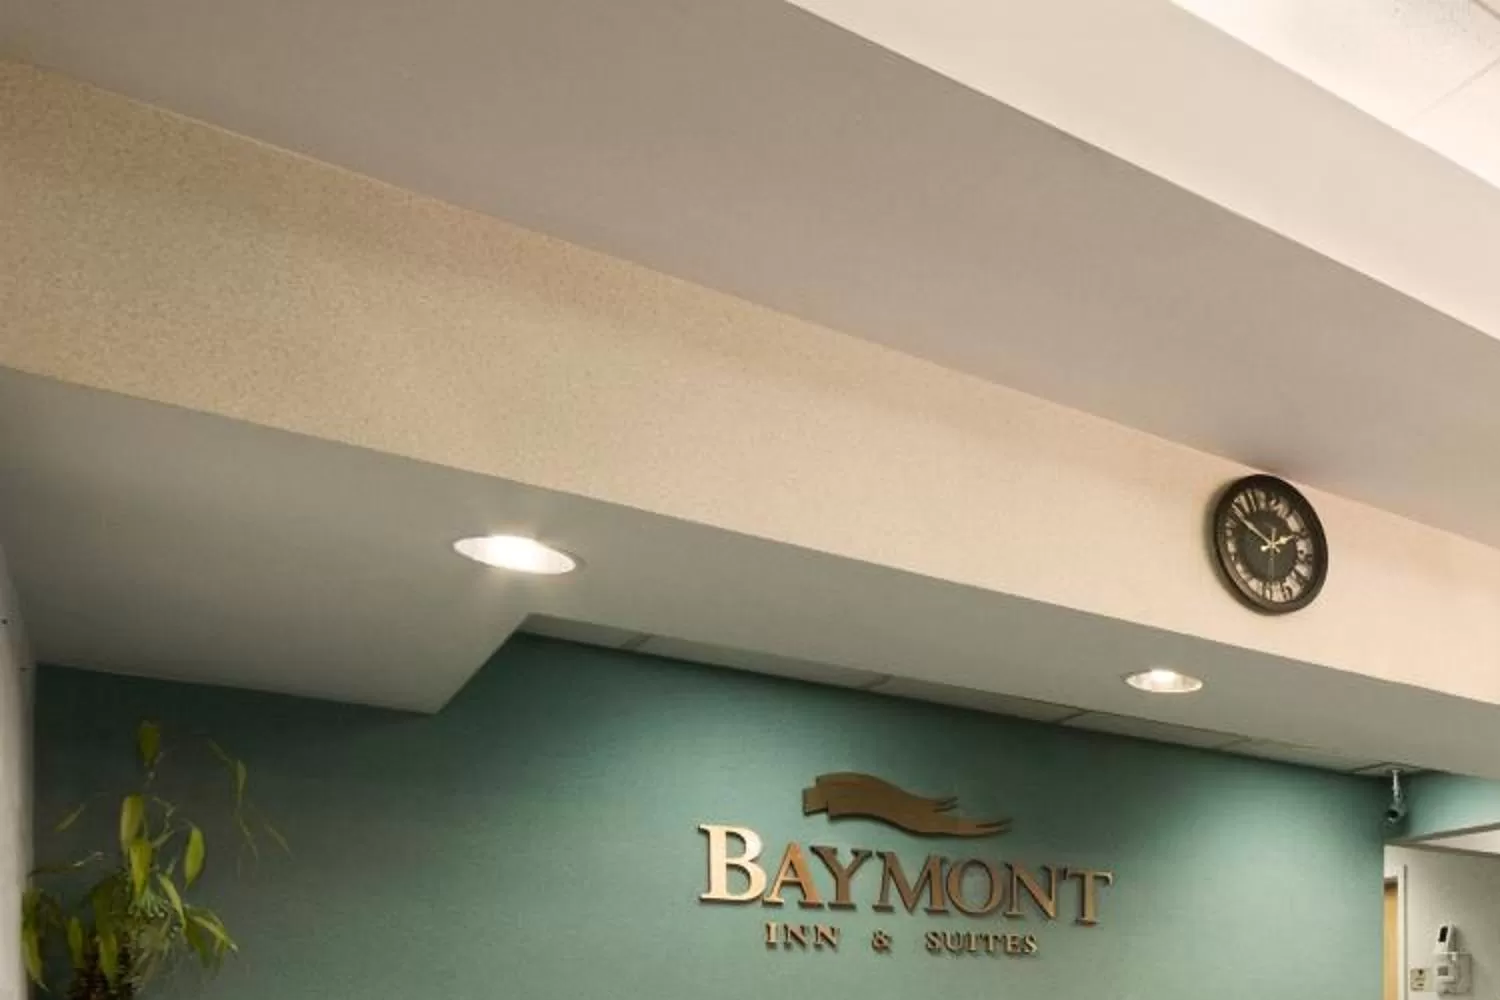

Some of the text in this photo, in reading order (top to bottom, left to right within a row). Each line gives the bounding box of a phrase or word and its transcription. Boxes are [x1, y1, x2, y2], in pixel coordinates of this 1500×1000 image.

[698, 823, 1114, 926] BAYMONT
[764, 920, 1039, 956] INN & SUITES
